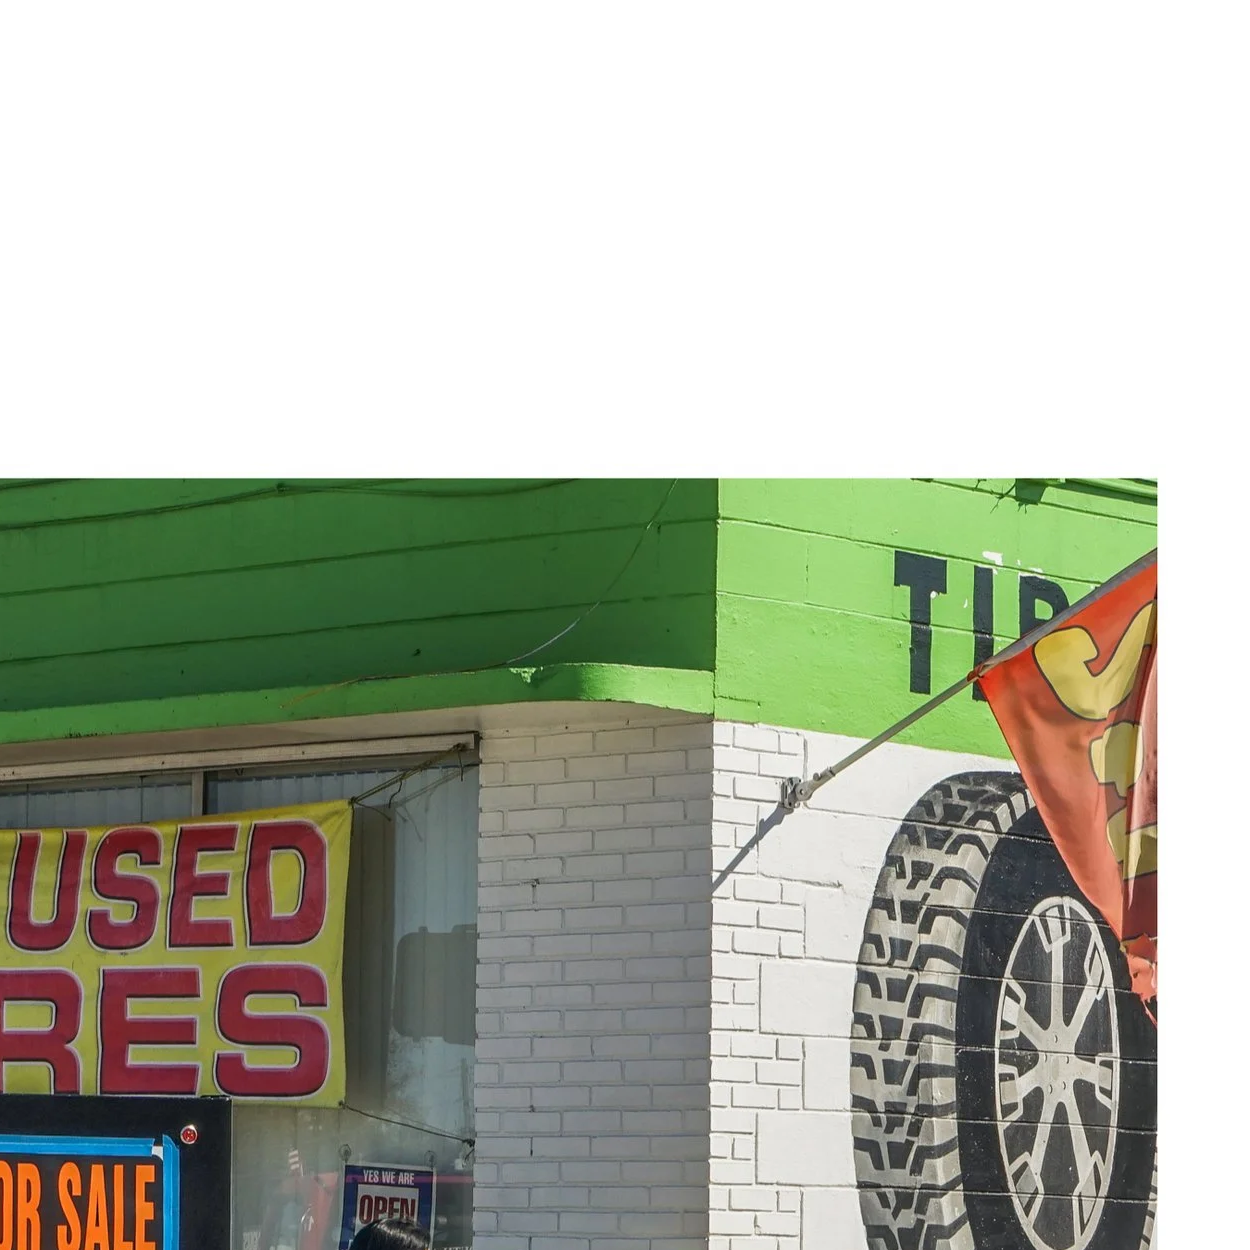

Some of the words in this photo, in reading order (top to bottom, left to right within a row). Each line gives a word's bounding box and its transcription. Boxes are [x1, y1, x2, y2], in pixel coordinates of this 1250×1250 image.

[6, 818, 328, 953] USED
[363, 1169, 379, 1184] YES
[382, 1171, 396, 1184] WE
[398, 1172, 415, 1186] ARE
[358, 1194, 416, 1225] OPEN
